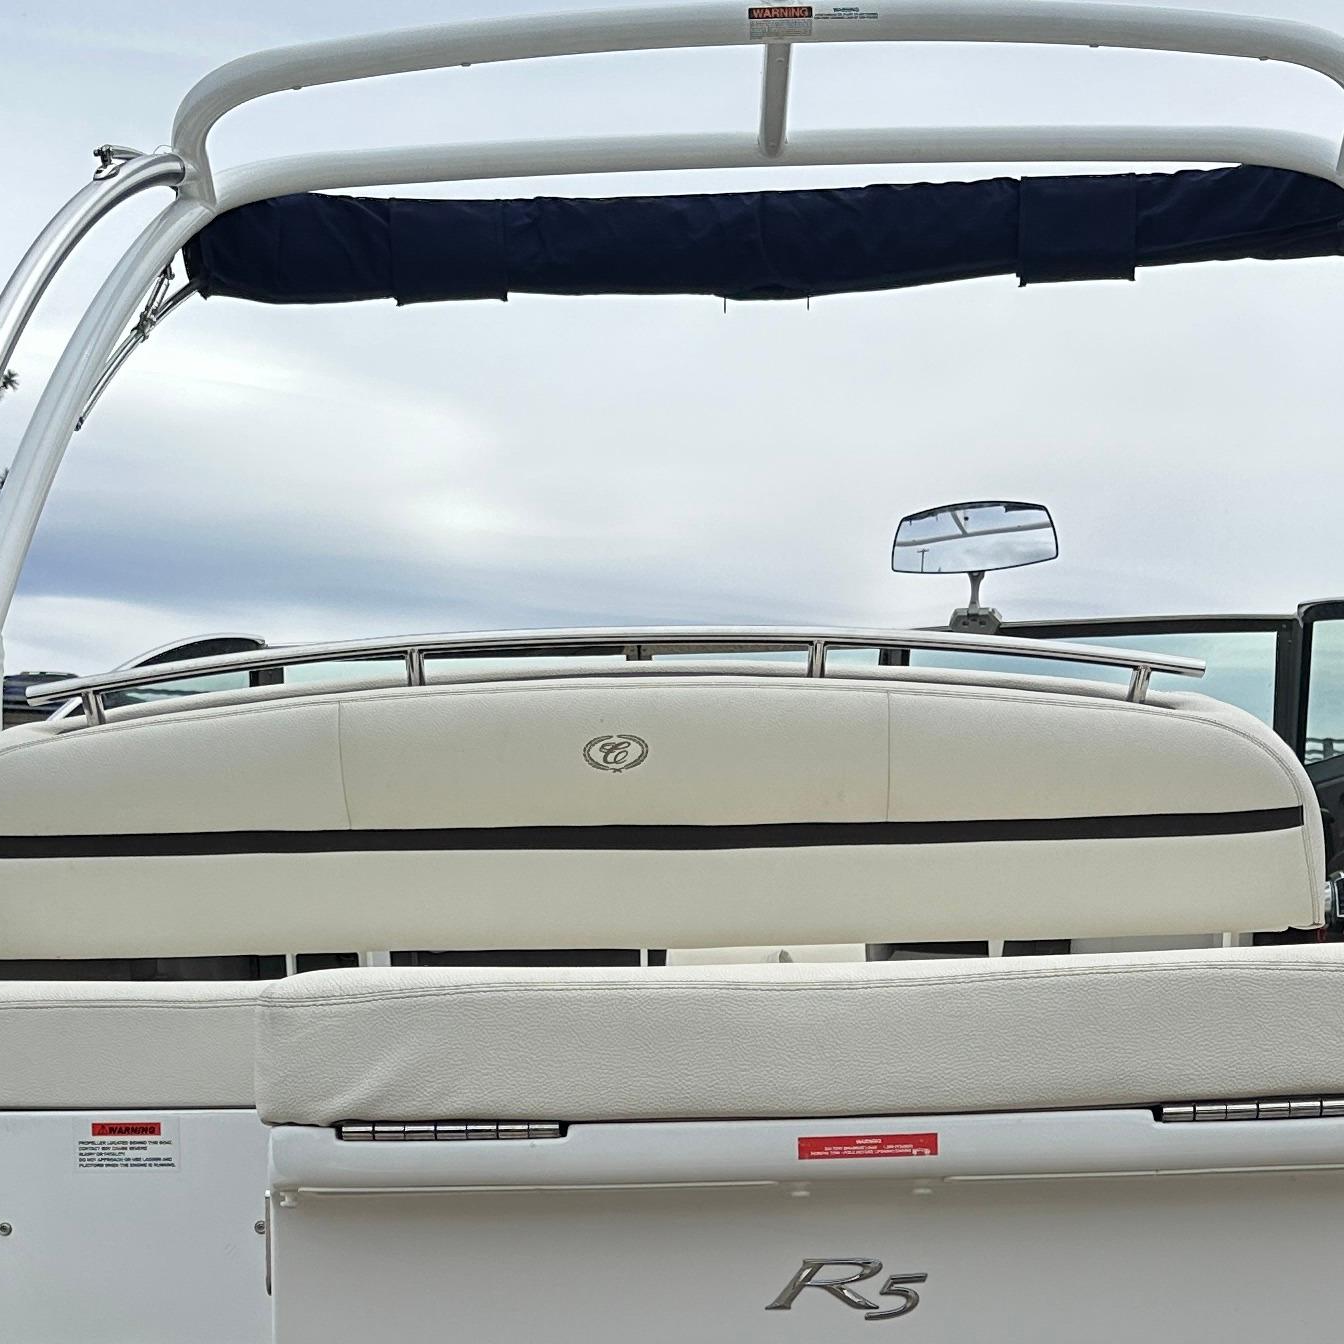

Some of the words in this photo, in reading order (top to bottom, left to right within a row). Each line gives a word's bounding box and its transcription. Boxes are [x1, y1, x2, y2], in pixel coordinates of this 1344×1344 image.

[753, 7, 809, 18] WARNING
[108, 1126, 156, 1135] WARNING
[765, 1257, 929, 1321] R5
